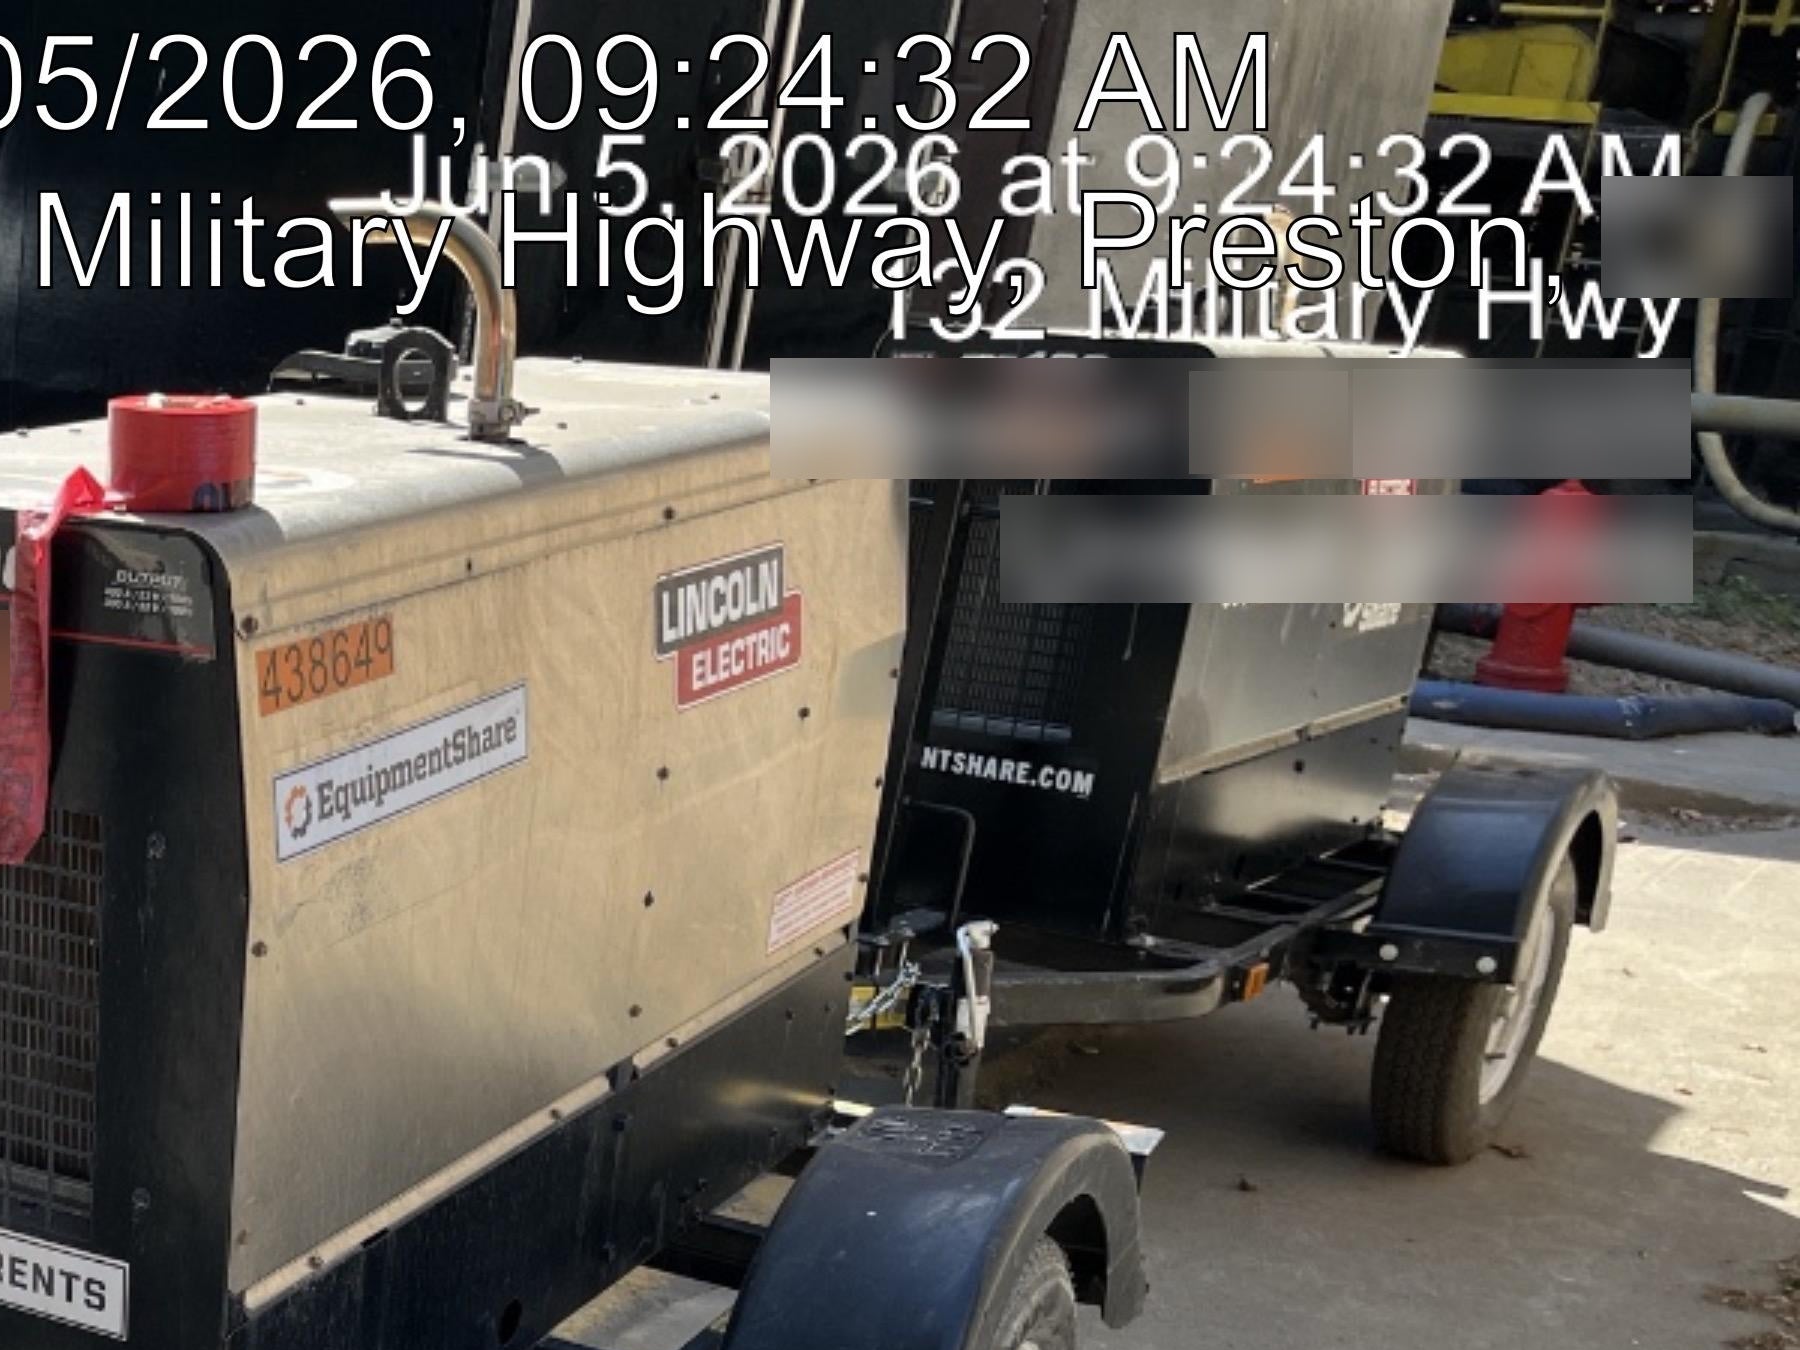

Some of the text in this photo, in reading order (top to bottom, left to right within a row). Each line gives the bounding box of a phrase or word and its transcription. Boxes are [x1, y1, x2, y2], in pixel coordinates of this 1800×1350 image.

[661, 558, 779, 643] LINCOLN
[261, 616, 394, 709] 438649
[691, 622, 791, 691] ELECTRIC
[317, 715, 518, 822] EquipmentShare
